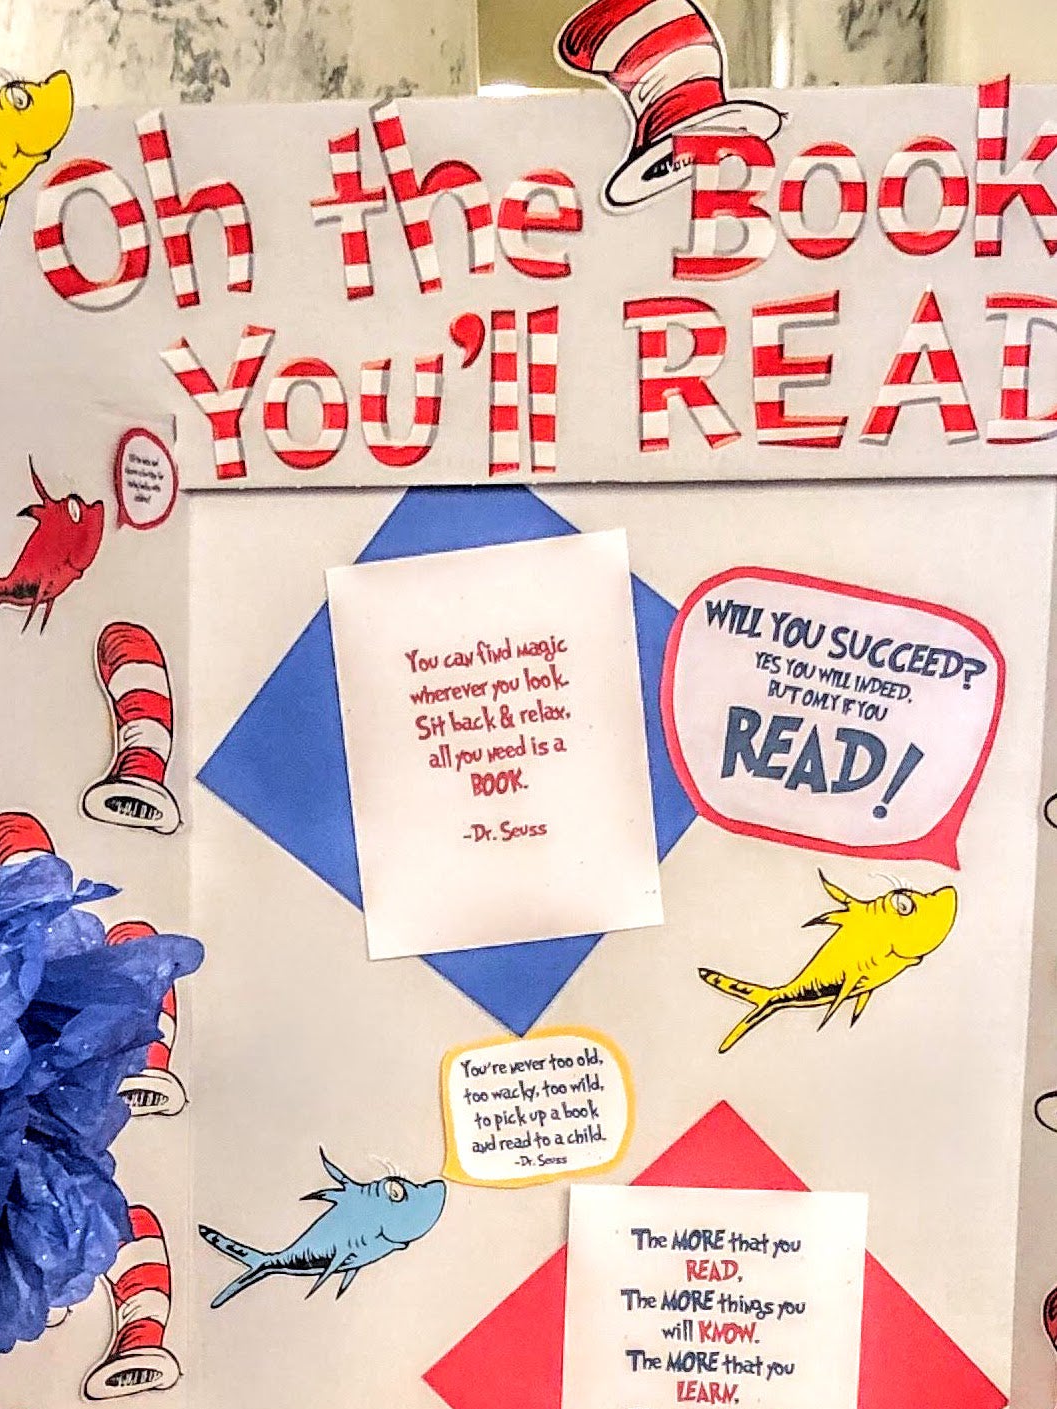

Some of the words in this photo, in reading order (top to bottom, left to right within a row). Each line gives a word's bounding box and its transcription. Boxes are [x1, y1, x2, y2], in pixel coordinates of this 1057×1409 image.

[33, 108, 256, 310] Oh
[310, 93, 584, 300] the
[159, 303, 559, 481] You'll
[622, 289, 1057, 454] READ
[404, 649, 439, 673] You
[443, 651, 474, 668] can
[476, 637, 512, 666] find
[516, 635, 569, 663] magic
[705, 599, 765, 639] WILL
[771, 611, 827, 650] YOU
[827, 625, 988, 691] SUCCEED?
[410, 681, 488, 705] wherever
[492, 677, 520, 702] you
[523, 663, 570, 692] look.
[755, 650, 782, 676] YES
[785, 657, 817, 680] YOU
[819, 667, 851, 691] WILL
[767, 679, 803, 705] BUT
[801, 687, 842, 712] ONLY
[842, 698, 858, 716] IF
[856, 699, 889, 723] YOU
[415, 714, 447, 741] Sit
[448, 705, 498, 733] back
[499, 703, 516, 730] &
[429, 743, 453, 769] all
[455, 747, 483, 772] you
[487, 733, 527, 764] need
[530, 736, 550, 757] is
[553, 736, 568, 753] a
[720, 704, 925, 819] READ!
[470, 766, 530, 797] BOOK.
[500, 819, 549, 842] Seuss
[460, 1058, 508, 1079] You're
[509, 1057, 547, 1075] never
[548, 1052, 575, 1071] too
[576, 1046, 604, 1068] old,
[463, 1087, 490, 1106] too
[491, 1079, 541, 1103] wacky,
[542, 1079, 568, 1098] too
[569, 1072, 605, 1093] wild,
[474, 1111, 492, 1130] to
[494, 1104, 528, 1132] pick
[529, 1108, 547, 1128] up
[550, 1107, 562, 1121] a
[560, 1098, 600, 1120] book
[472, 1133, 496, 1154] and
[498, 1129, 532, 1151] read
[533, 1131, 551, 1149] to
[554, 1133, 566, 1146] a
[566, 1122, 607, 1145] child.
[537, 1153, 568, 1167] Seuss
[631, 1227, 668, 1251] The
[671, 1227, 726, 1252] MORE
[728, 1231, 770, 1254] that
[772, 1238, 802, 1259] you
[685, 1258, 744, 1283] READ,
[620, 1287, 657, 1311] The
[660, 1288, 716, 1313] MORE
[716, 1291, 775, 1321] things
[777, 1300, 806, 1321] you
[661, 1318, 694, 1342] will
[698, 1318, 761, 1345] KNOW.
[625, 1349, 662, 1373] The
[665, 1350, 720, 1375] MORE
[721, 1353, 763, 1377] that
[765, 1361, 796, 1382] you
[676, 1380, 740, 1405] LEARN,
